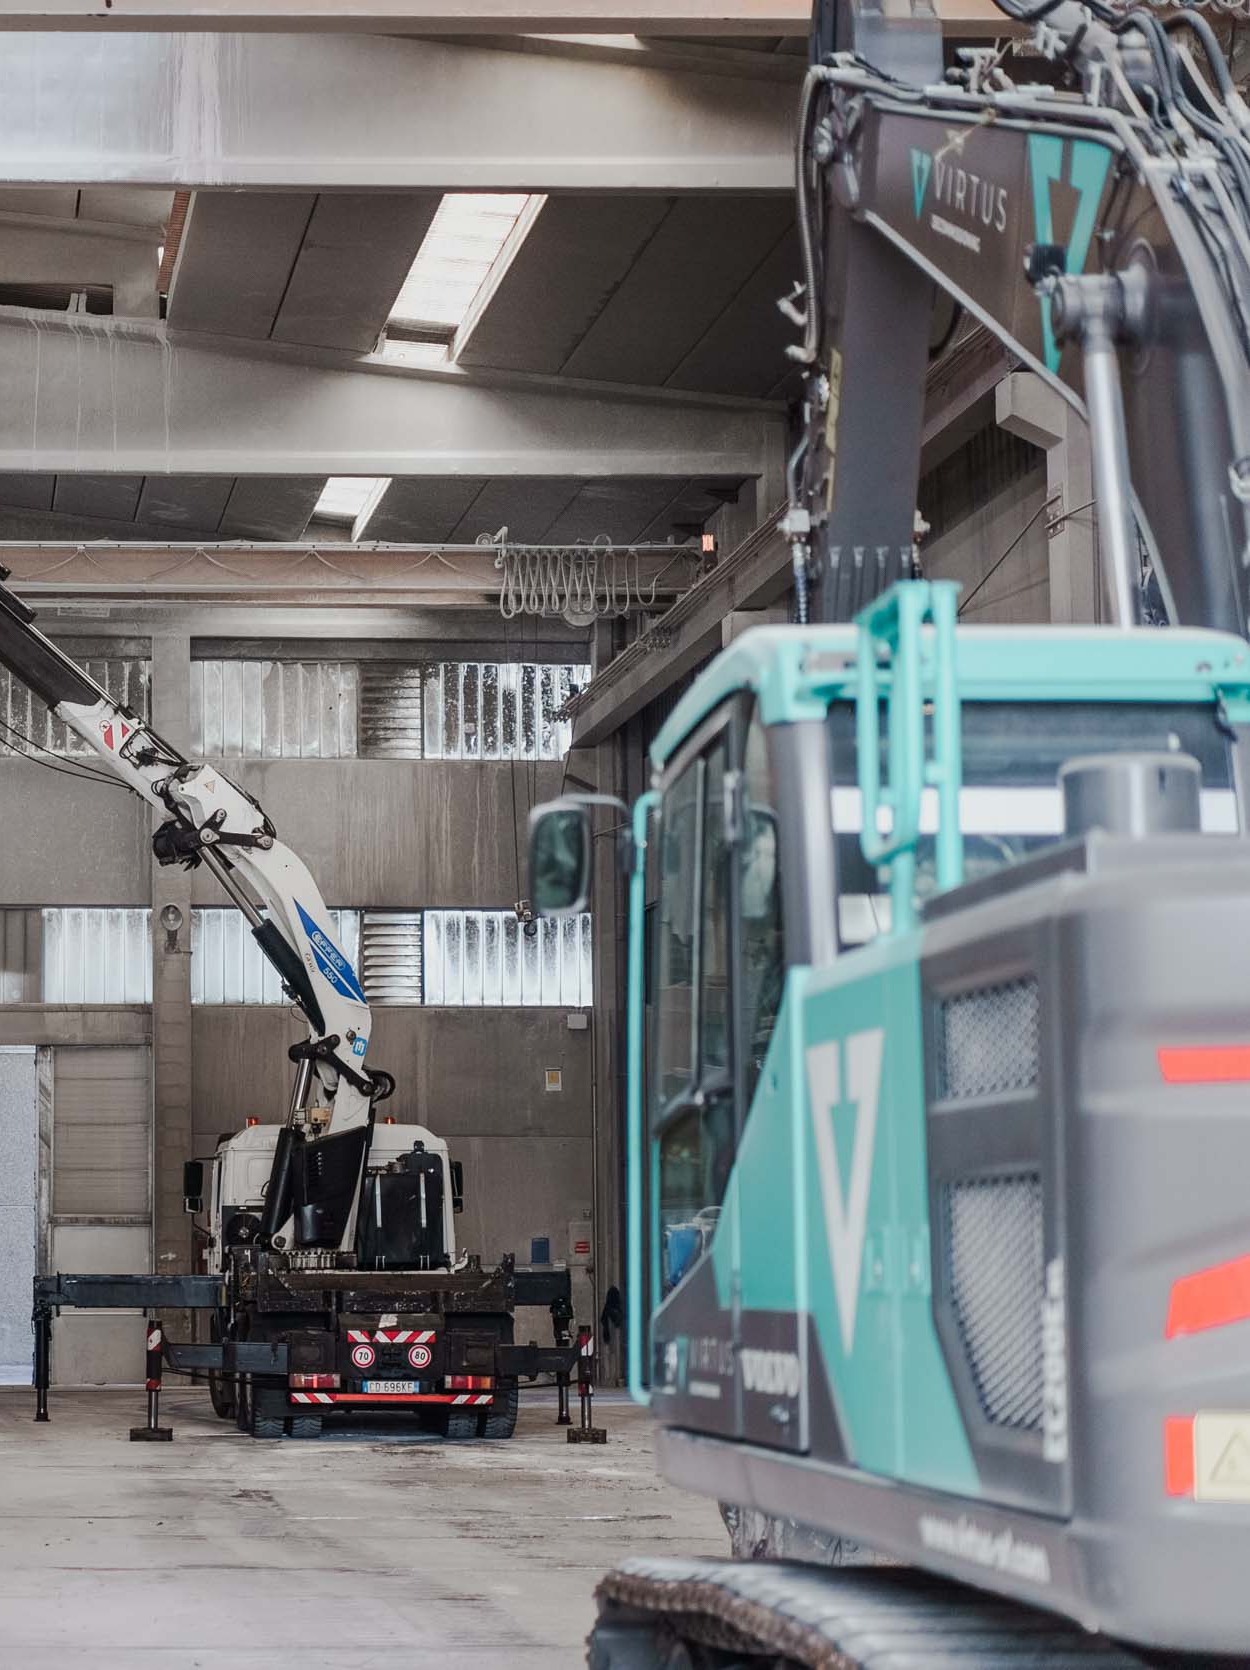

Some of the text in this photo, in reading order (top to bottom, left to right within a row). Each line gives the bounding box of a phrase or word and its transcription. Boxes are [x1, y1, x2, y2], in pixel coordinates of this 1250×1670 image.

[934, 156, 1007, 232] VIRTUS
[323, 967, 338, 984] 550
[358, 1351, 369, 1361] 70
[414, 1350, 426, 1361] 80
